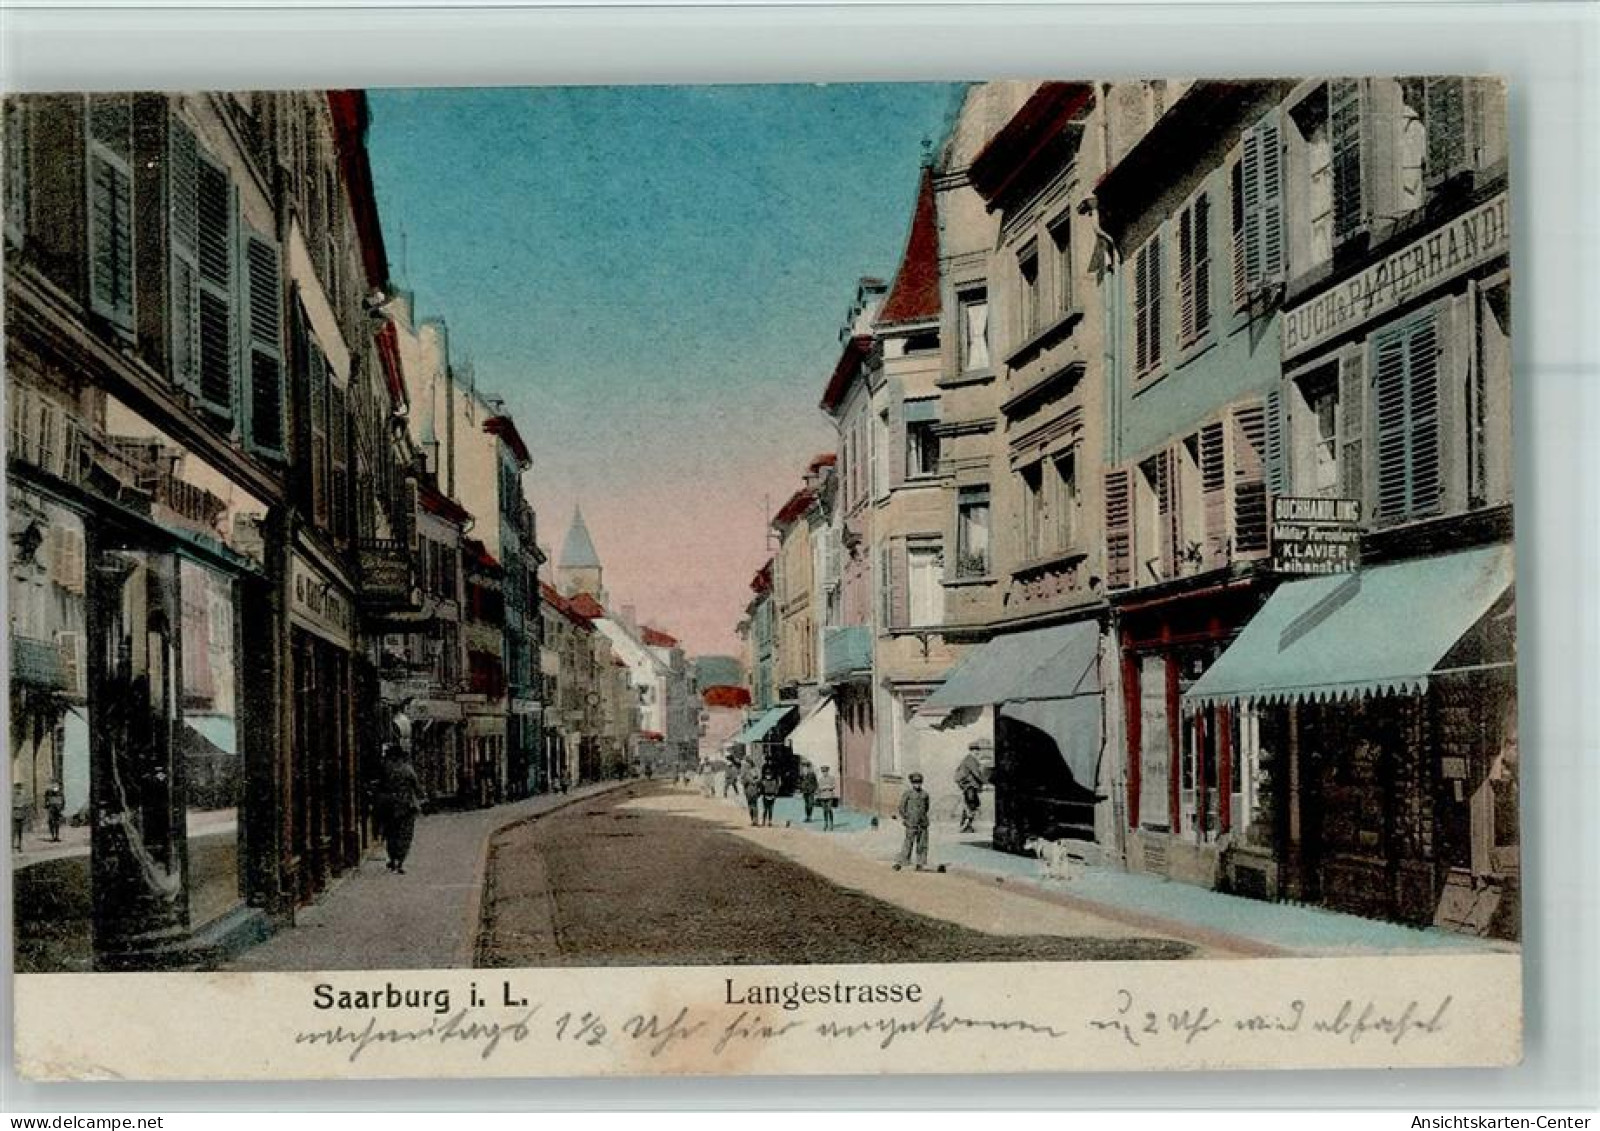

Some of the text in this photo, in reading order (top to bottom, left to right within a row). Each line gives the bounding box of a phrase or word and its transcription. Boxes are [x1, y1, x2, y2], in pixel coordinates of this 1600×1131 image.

[1285, 289, 1337, 350] BUCH
[1283, 543, 1347, 558] KLAVIER
[312, 981, 529, 1014] Saarburg i. L.
[724, 978, 922, 1010] Langestrasse
